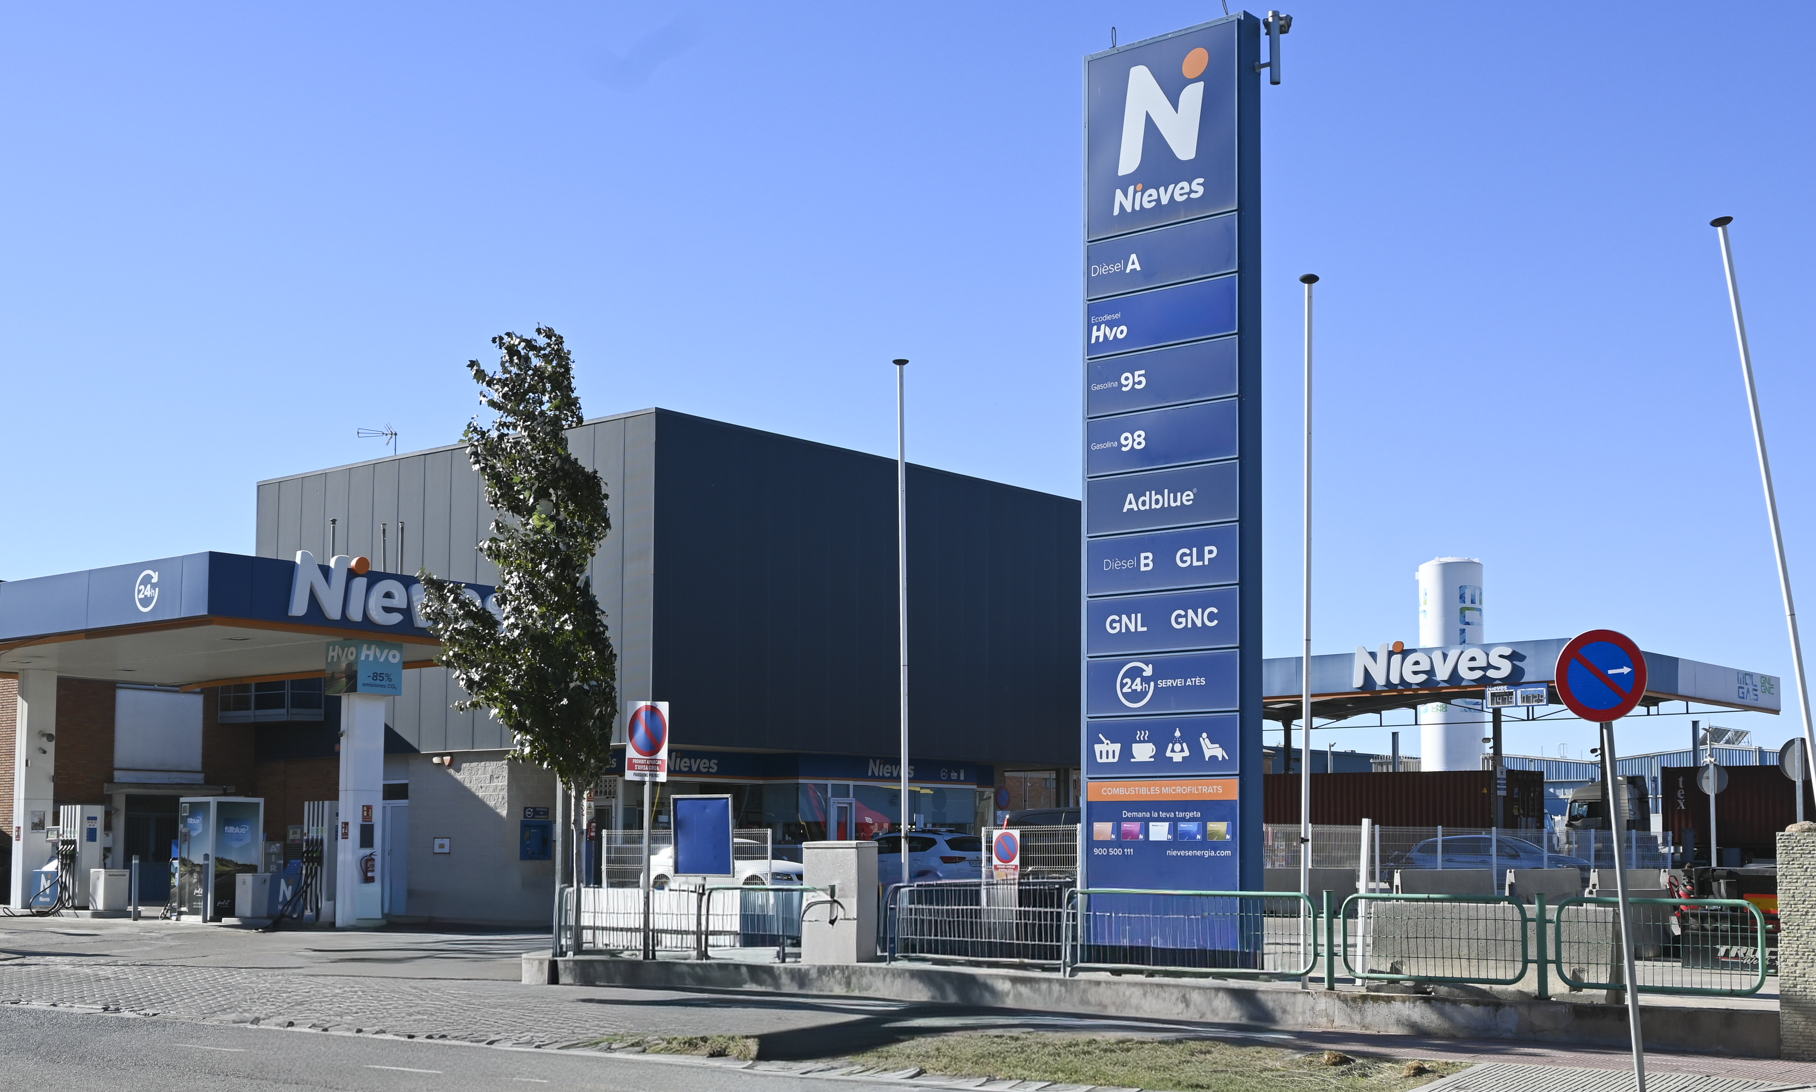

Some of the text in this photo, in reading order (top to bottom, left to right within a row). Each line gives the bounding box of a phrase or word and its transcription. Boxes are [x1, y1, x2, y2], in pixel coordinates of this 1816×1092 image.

[1113, 177, 1205, 216] Nieves
[1091, 253, 1141, 277] Dièsel A
[1091, 311, 1121, 324] Ecodiesel
[1090, 323, 1128, 344] Hvo
[1091, 369, 1147, 392] Gasolina 95
[1091, 429, 1146, 452] Gasolina 98
[1103, 551, 1154, 572] Dièsel B
[1175, 545, 1218, 567] GLP
[138, 584, 155, 599] 24h
[1105, 612, 1148, 634] GNL
[1170, 606, 1219, 629] GNC
[360, 643, 401, 664] Hvo
[1353, 641, 1513, 689] Nieves
[367, 671, 393, 683] -85%
[1122, 675, 1206, 693] 24h SERVEI ATÈS
[1738, 685, 1759, 702] GAS
[667, 752, 718, 773] Nieves
[868, 758, 915, 778] Nievs
[1102, 785, 1223, 796] COMBUSTIBLES MICROFILTRATS
[1677, 775, 1686, 810] tex
[1122, 810, 1150, 818] Demana
[1151, 810, 1158, 818] la
[1175, 811, 1201, 820] targeta
[1093, 848, 1107, 856] 900
[1166, 849, 1232, 858] nievesenergia.com
